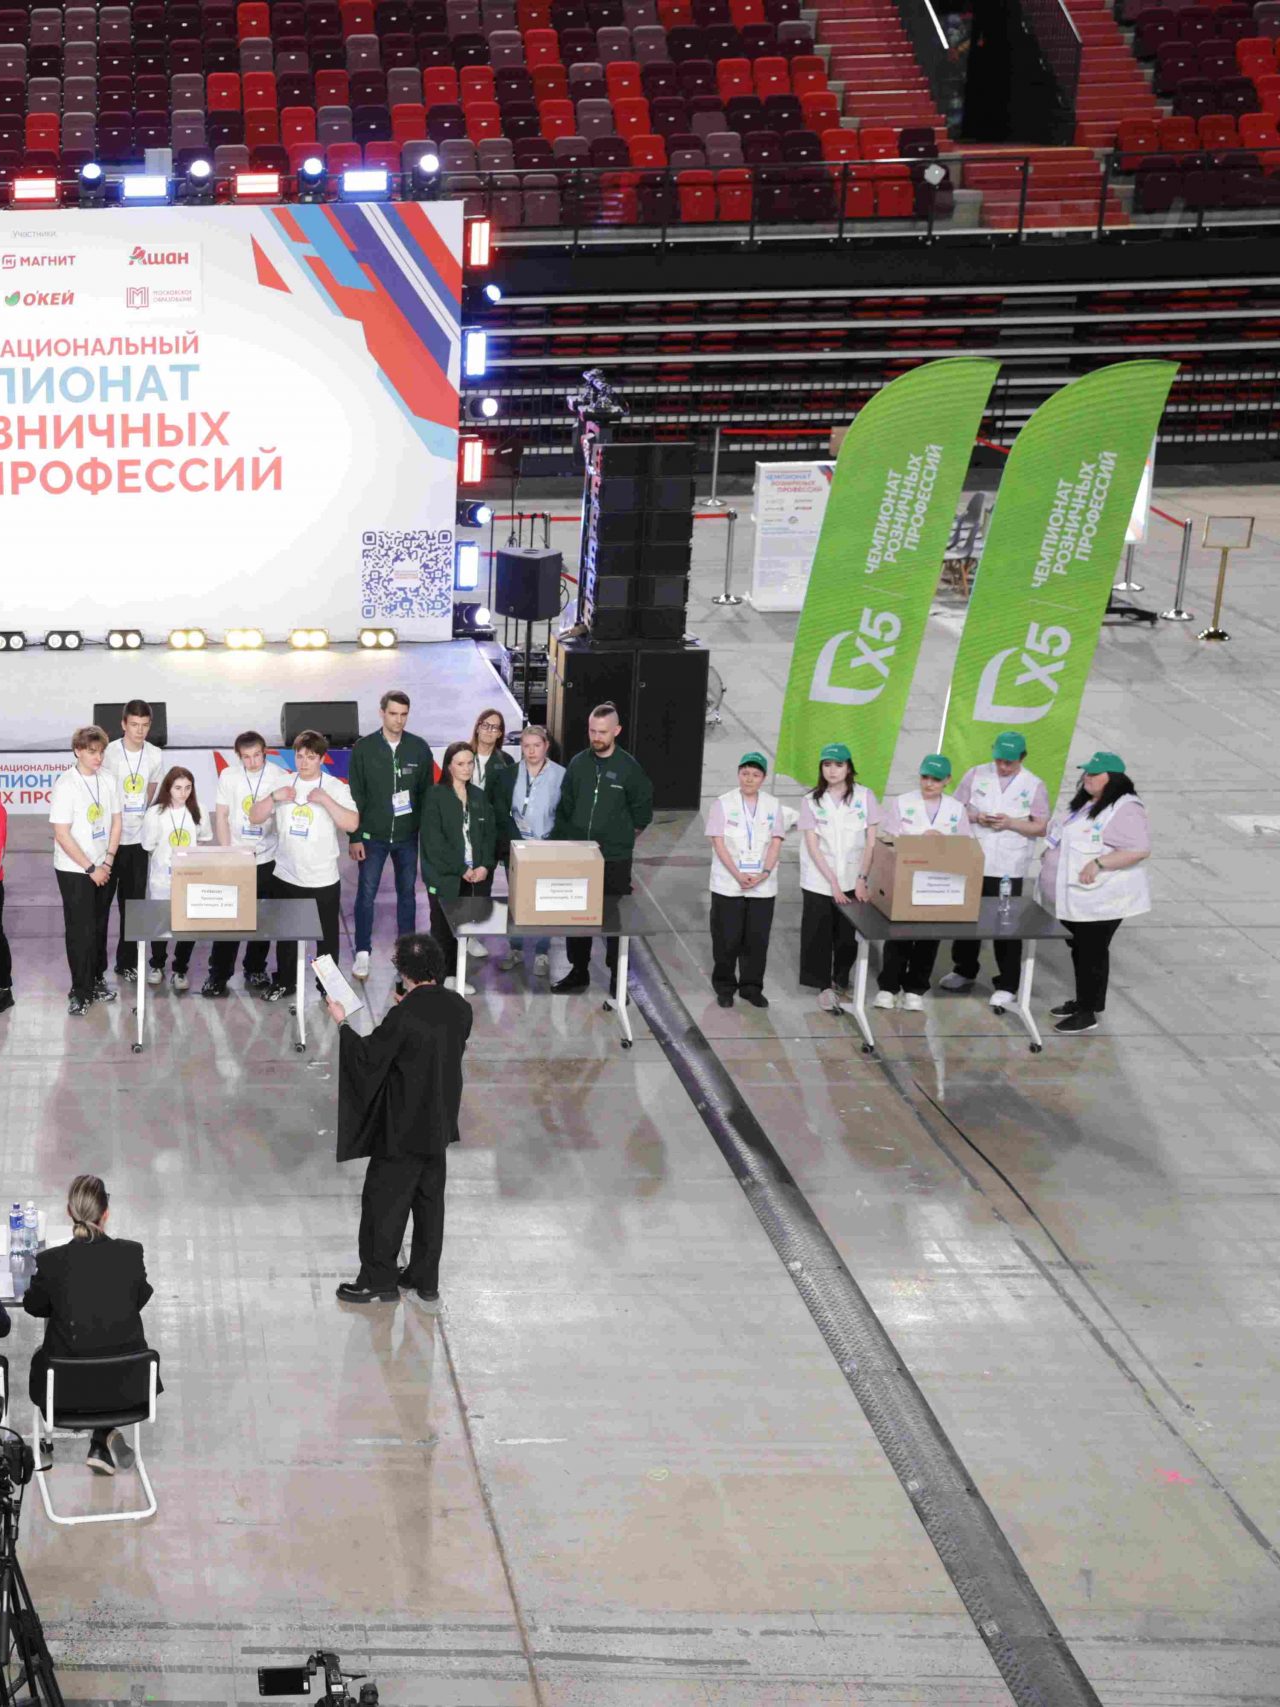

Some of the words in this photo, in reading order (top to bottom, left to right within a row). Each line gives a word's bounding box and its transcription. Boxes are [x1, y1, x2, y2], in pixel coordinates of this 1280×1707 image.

[19, 255, 76, 266] МАГНИТ
[864, 468, 902, 574] ЧЕМПИОНАТ
[883, 452, 923, 563] РОЗНИЧНЫХ
[903, 444, 944, 551] ПРОФЕССИЙ
[1031, 478, 1074, 588] ЧЕМПИОНАТ
[1052, 461, 1097, 575] РОЗНИЧНЫХ
[1075, 450, 1118, 561] ПРОФЕССИЙ
